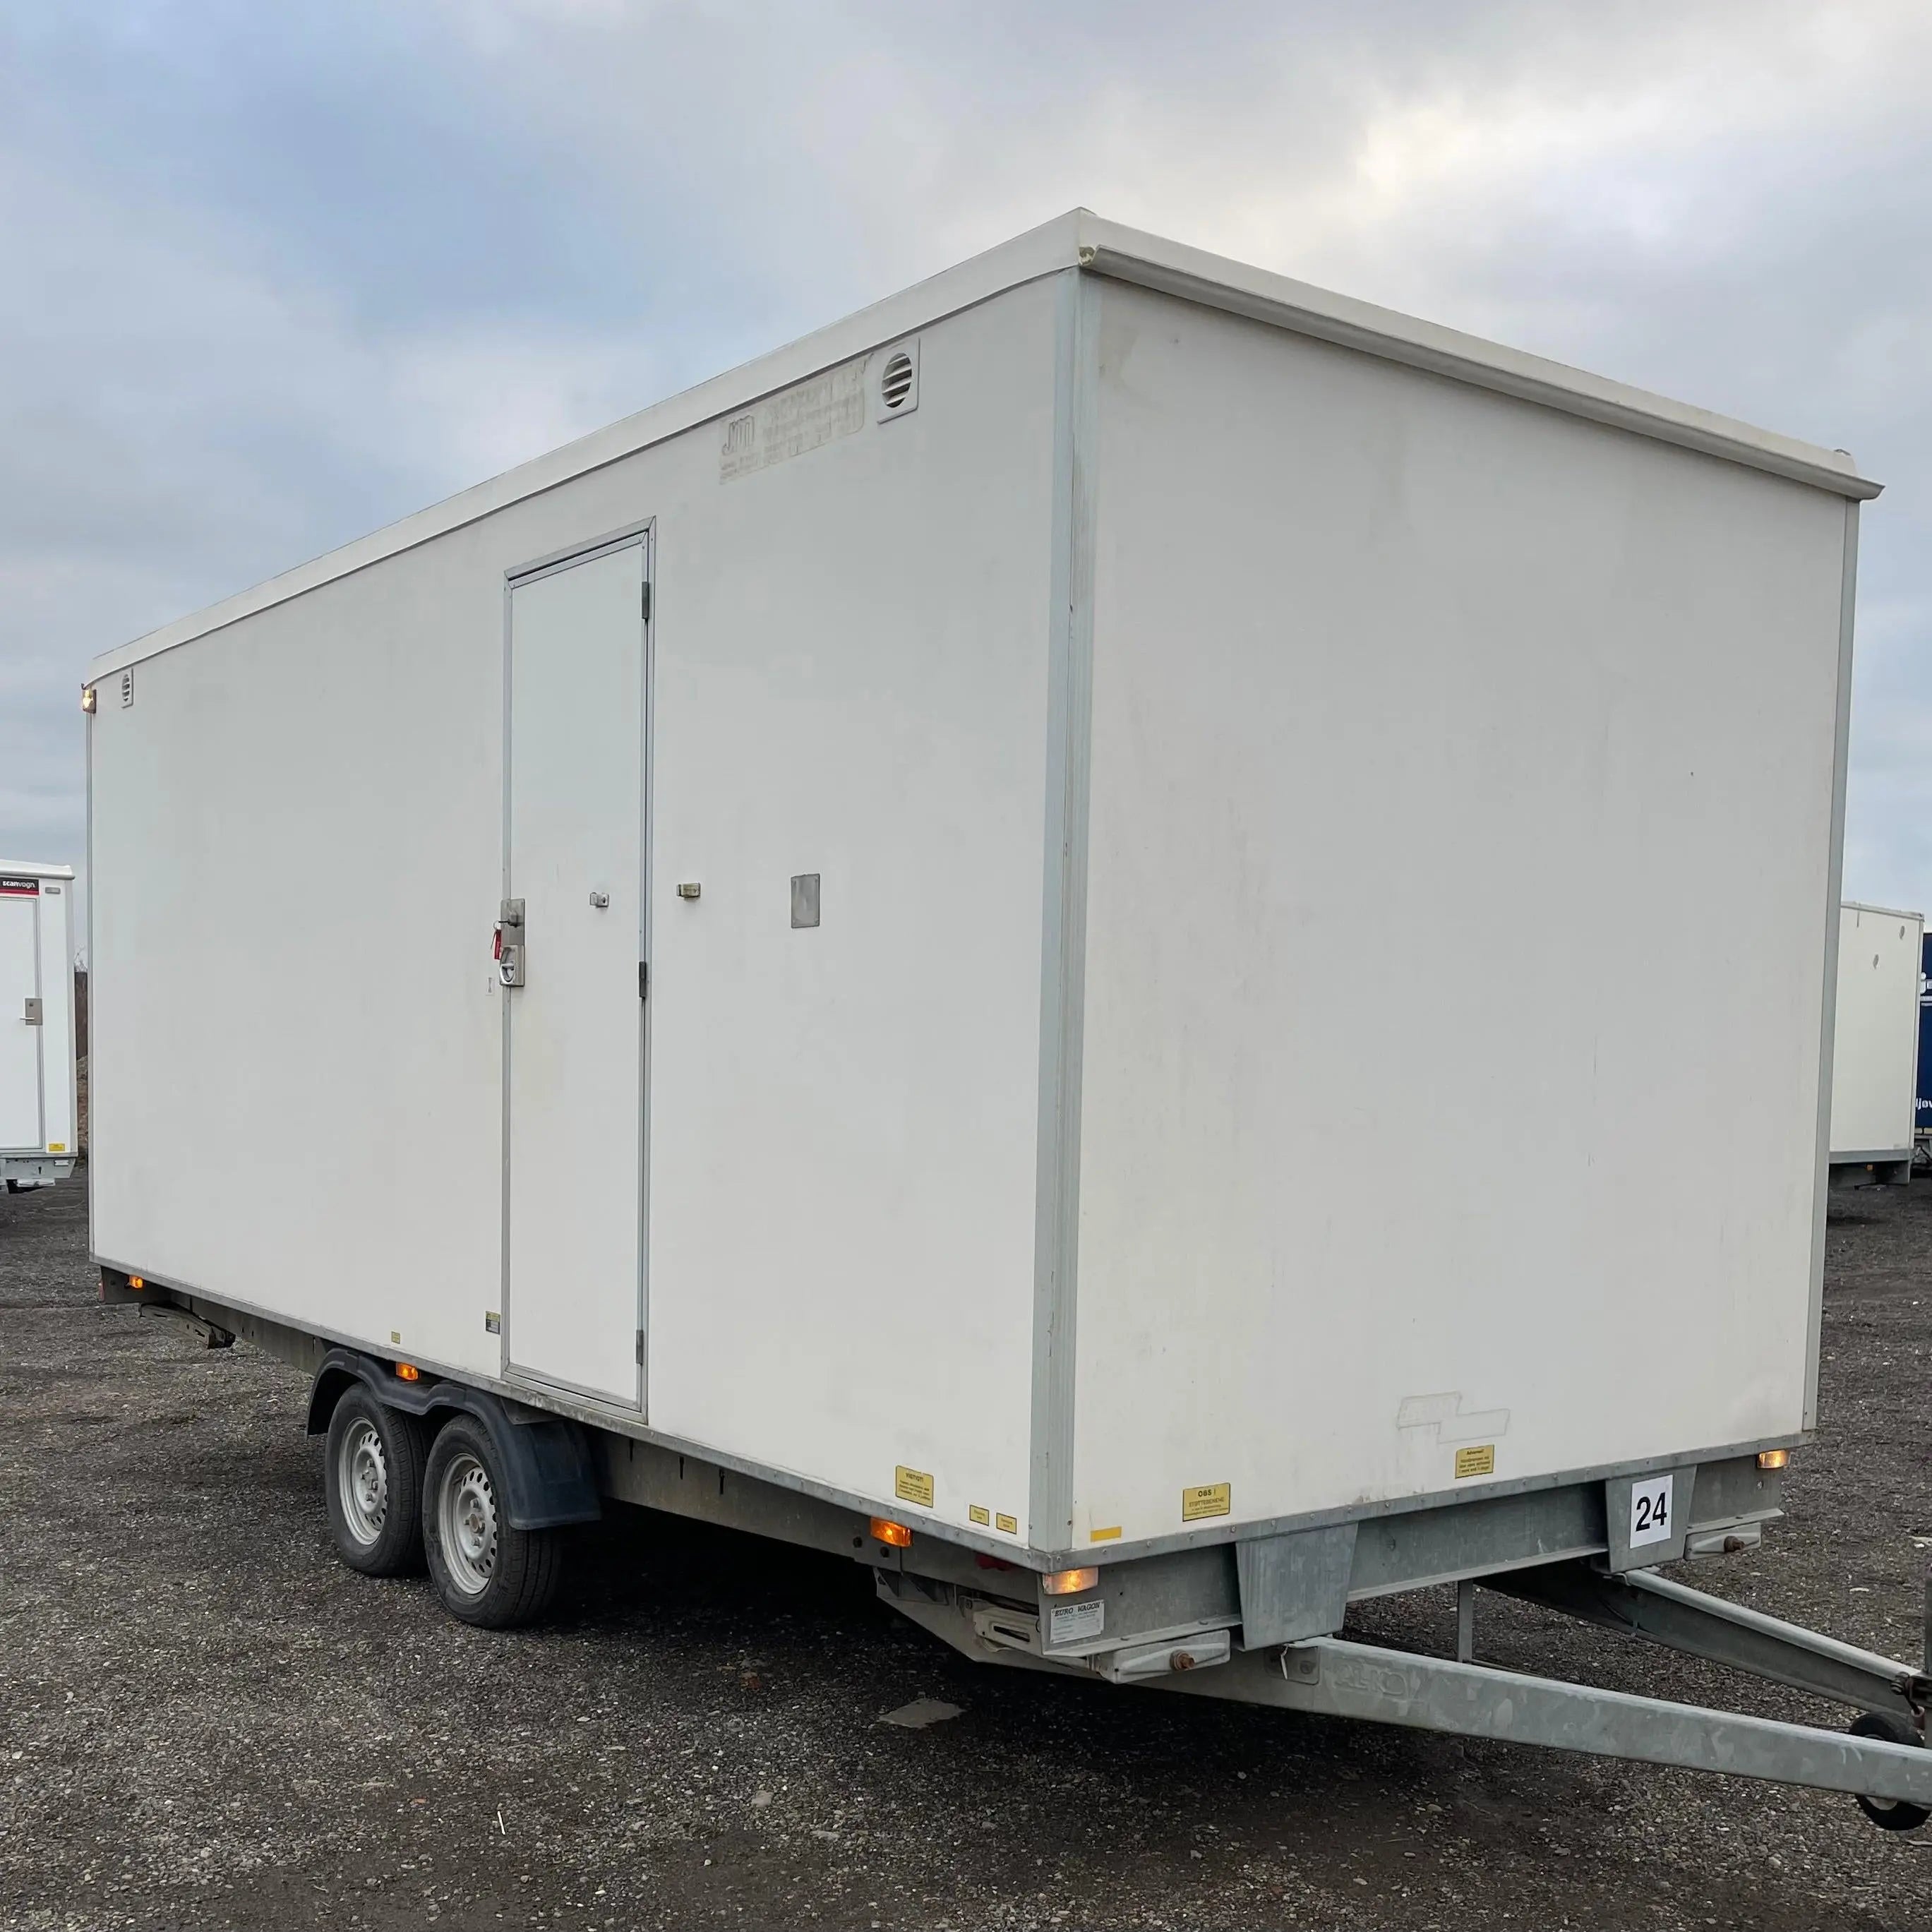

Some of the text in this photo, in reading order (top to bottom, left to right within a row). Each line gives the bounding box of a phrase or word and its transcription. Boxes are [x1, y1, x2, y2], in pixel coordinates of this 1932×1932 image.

[2, 880, 35, 889] scanvogn
[1198, 1489, 1212, 1497] OBS
[1636, 1492, 1667, 1532] 24
[1055, 1607, 1074, 1617] EURO
[1077, 1602, 1100, 1613] WAGON
